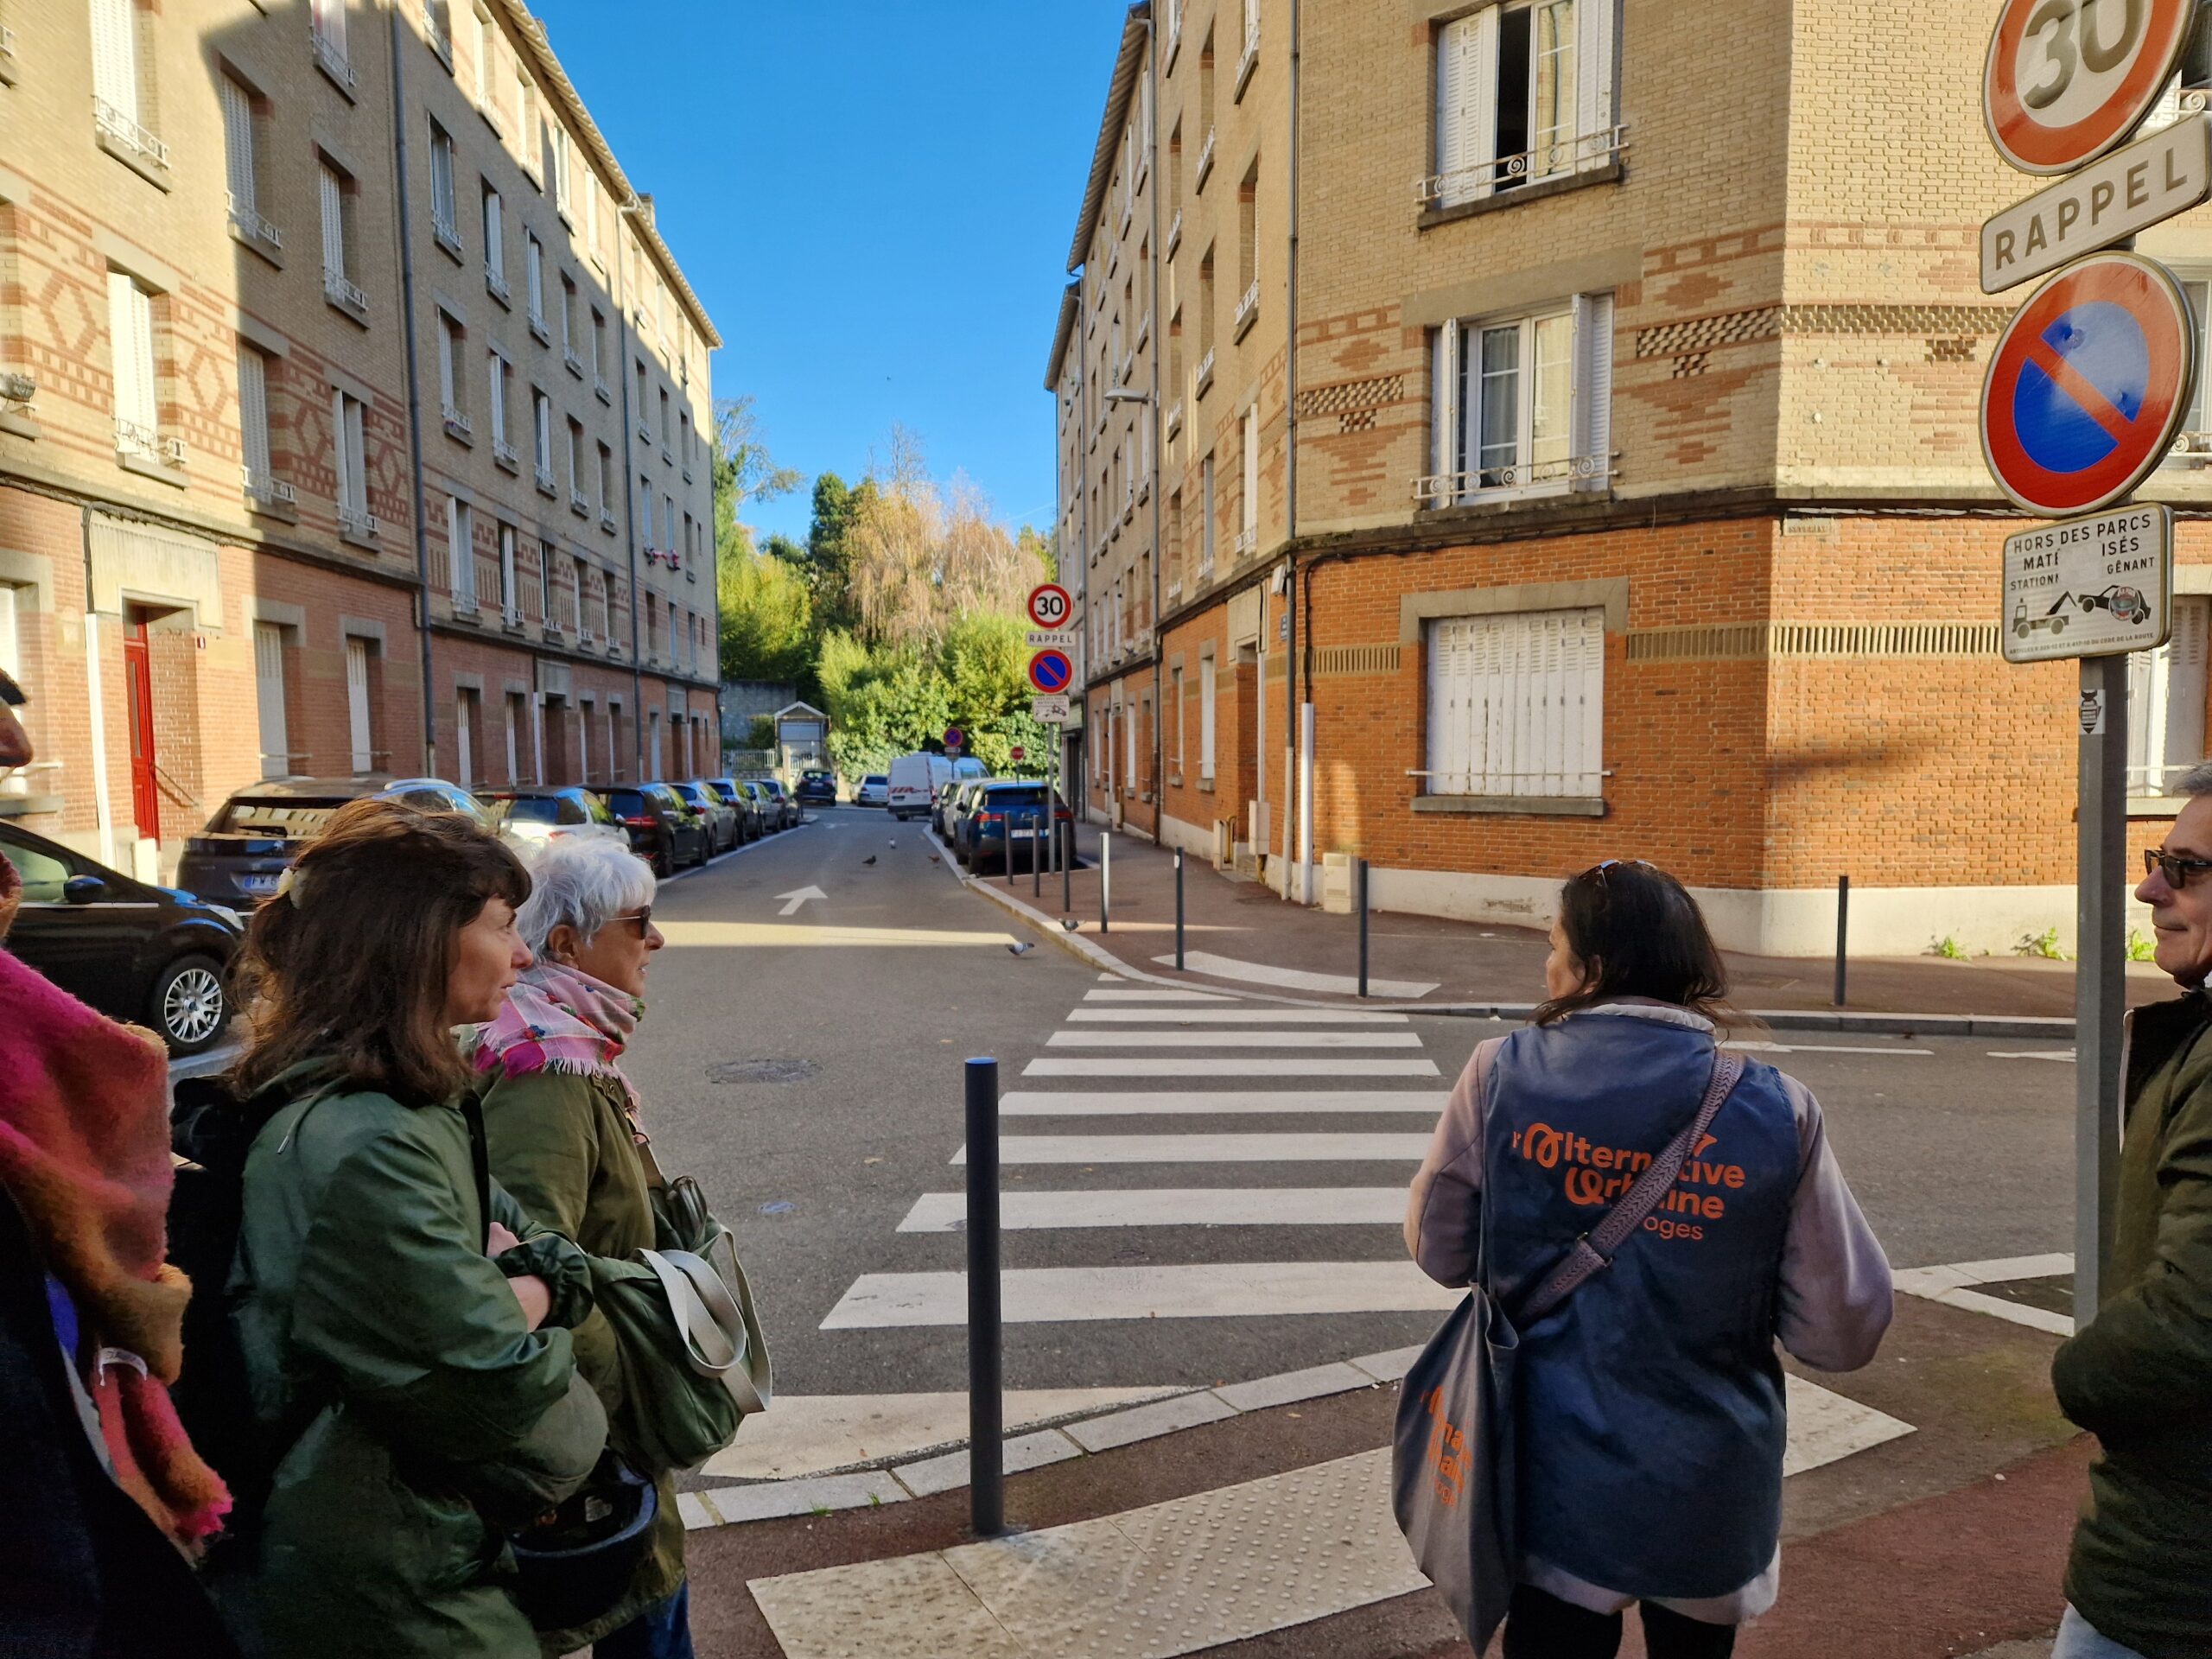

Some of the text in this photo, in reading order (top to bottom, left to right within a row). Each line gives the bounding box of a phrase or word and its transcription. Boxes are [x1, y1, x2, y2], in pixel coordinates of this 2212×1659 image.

[2023, 0, 2145, 110] 30
[1995, 147, 2188, 270] RAPPEL
[2013, 513, 2151, 554] HORS DES PARCS
[2010, 556, 2155, 591] STATION GÊNANT
[1036, 596, 1064, 616] 30
[1028, 634, 1072, 644] RAPPEL
[1565, 1166, 1726, 1220] Urine
[1643, 1216, 1703, 1241] oges
